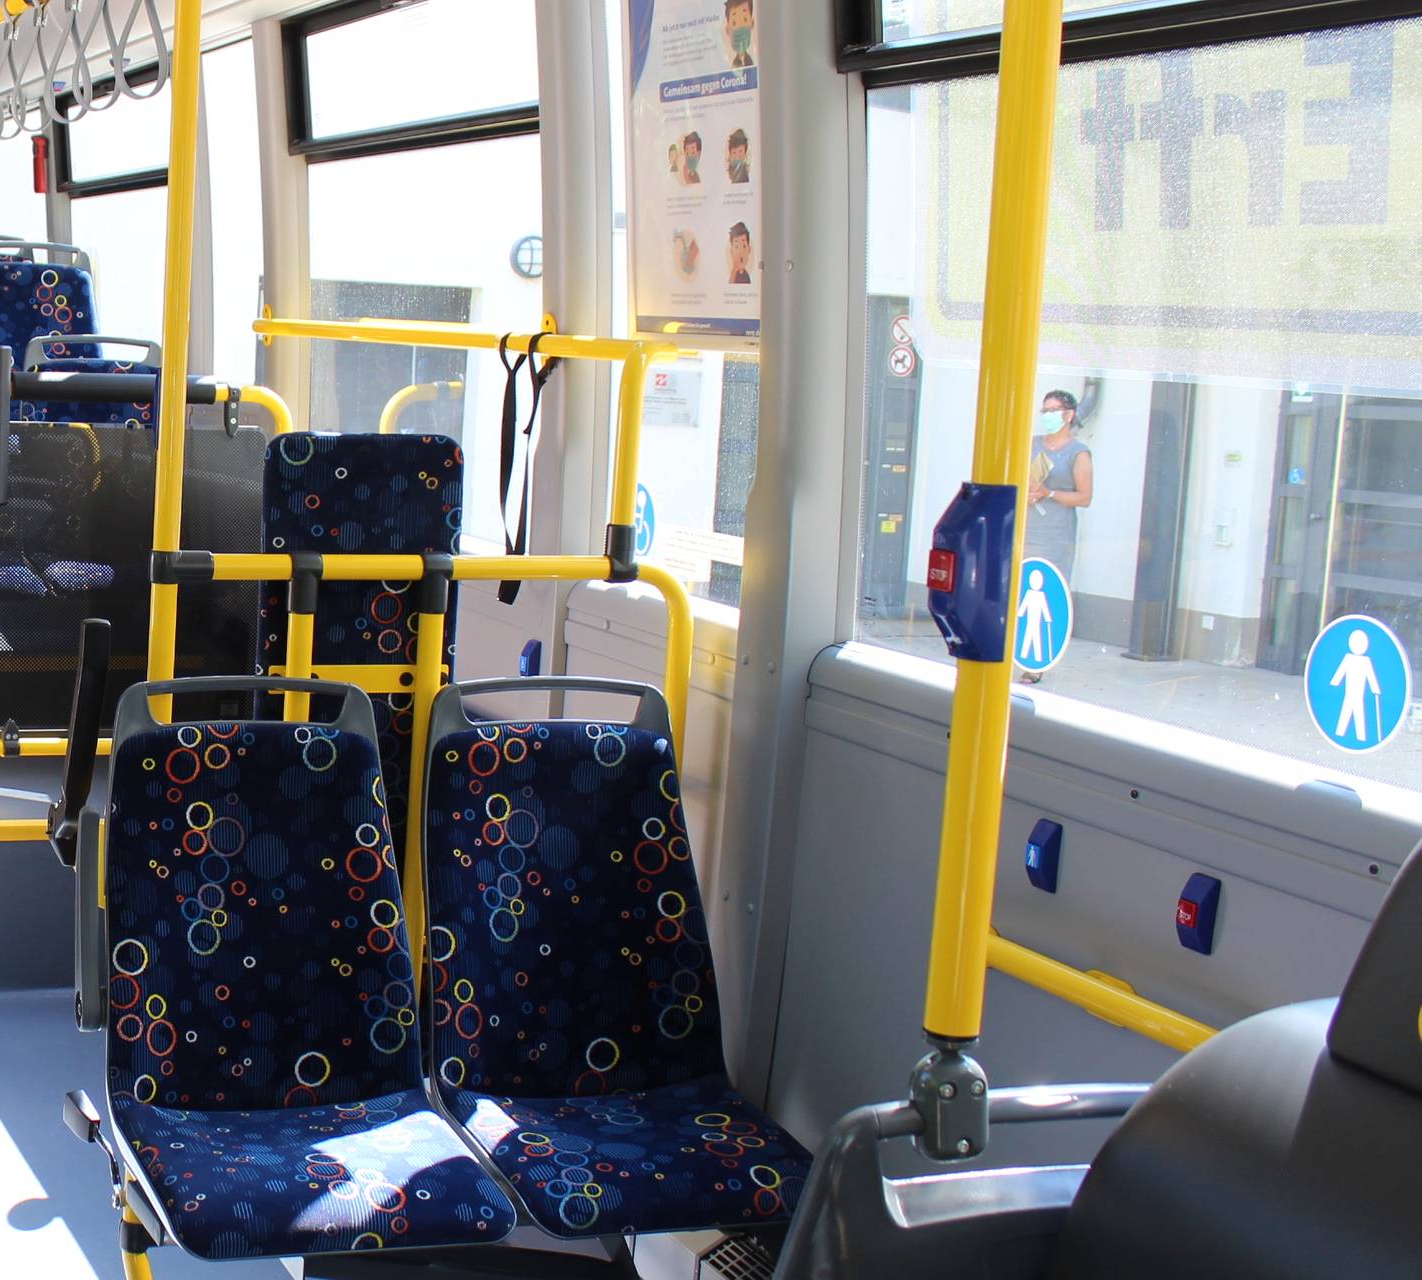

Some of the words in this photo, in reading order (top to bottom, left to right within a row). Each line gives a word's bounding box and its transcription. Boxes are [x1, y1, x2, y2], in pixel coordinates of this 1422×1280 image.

[663, 84, 700, 98] Gemeinsam
[700, 80, 720, 96] gegen
[720, 73, 747, 89] Corona!
[929, 567, 948, 582] STOP
